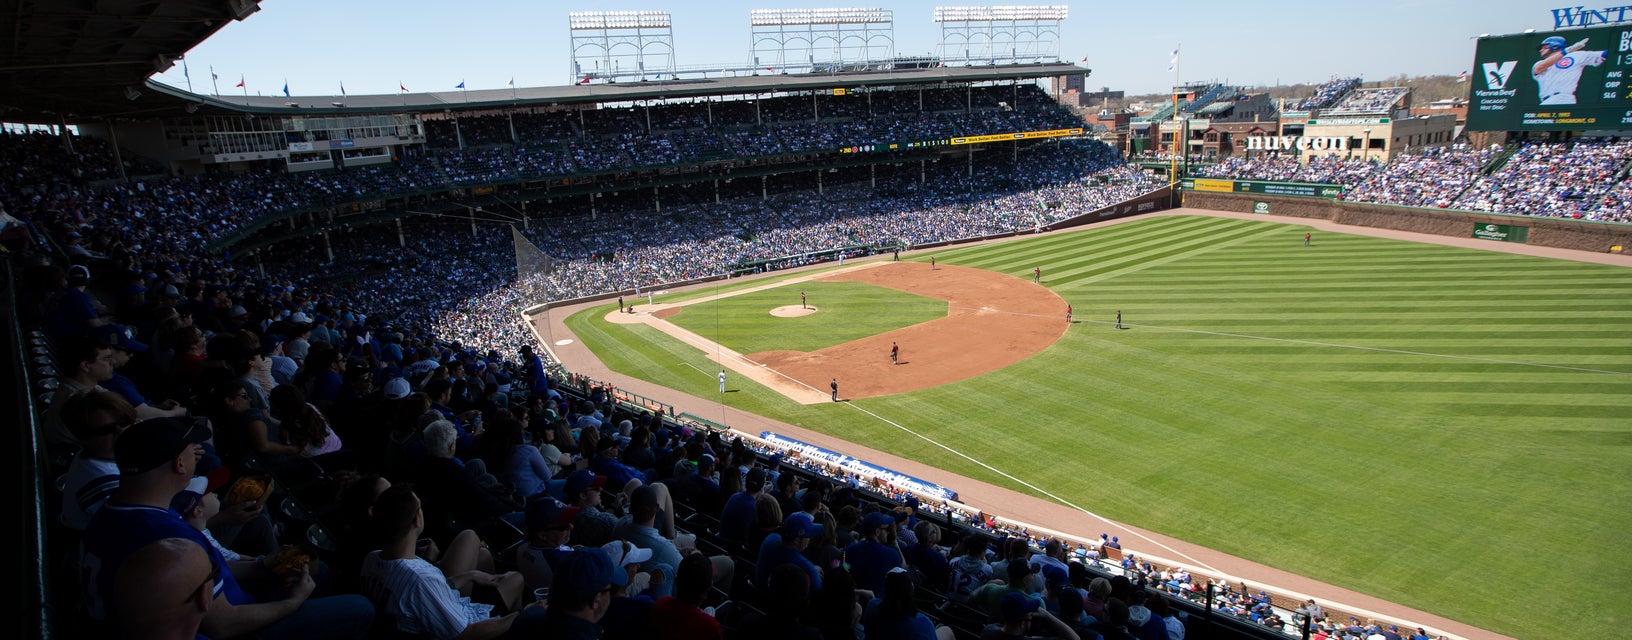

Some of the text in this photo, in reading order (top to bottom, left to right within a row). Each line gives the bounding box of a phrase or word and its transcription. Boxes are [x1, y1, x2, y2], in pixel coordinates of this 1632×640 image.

[1619, 39, 1632, 51] B
[1475, 89, 1499, 97] Vienna
[1247, 135, 1348, 150] nuveen
